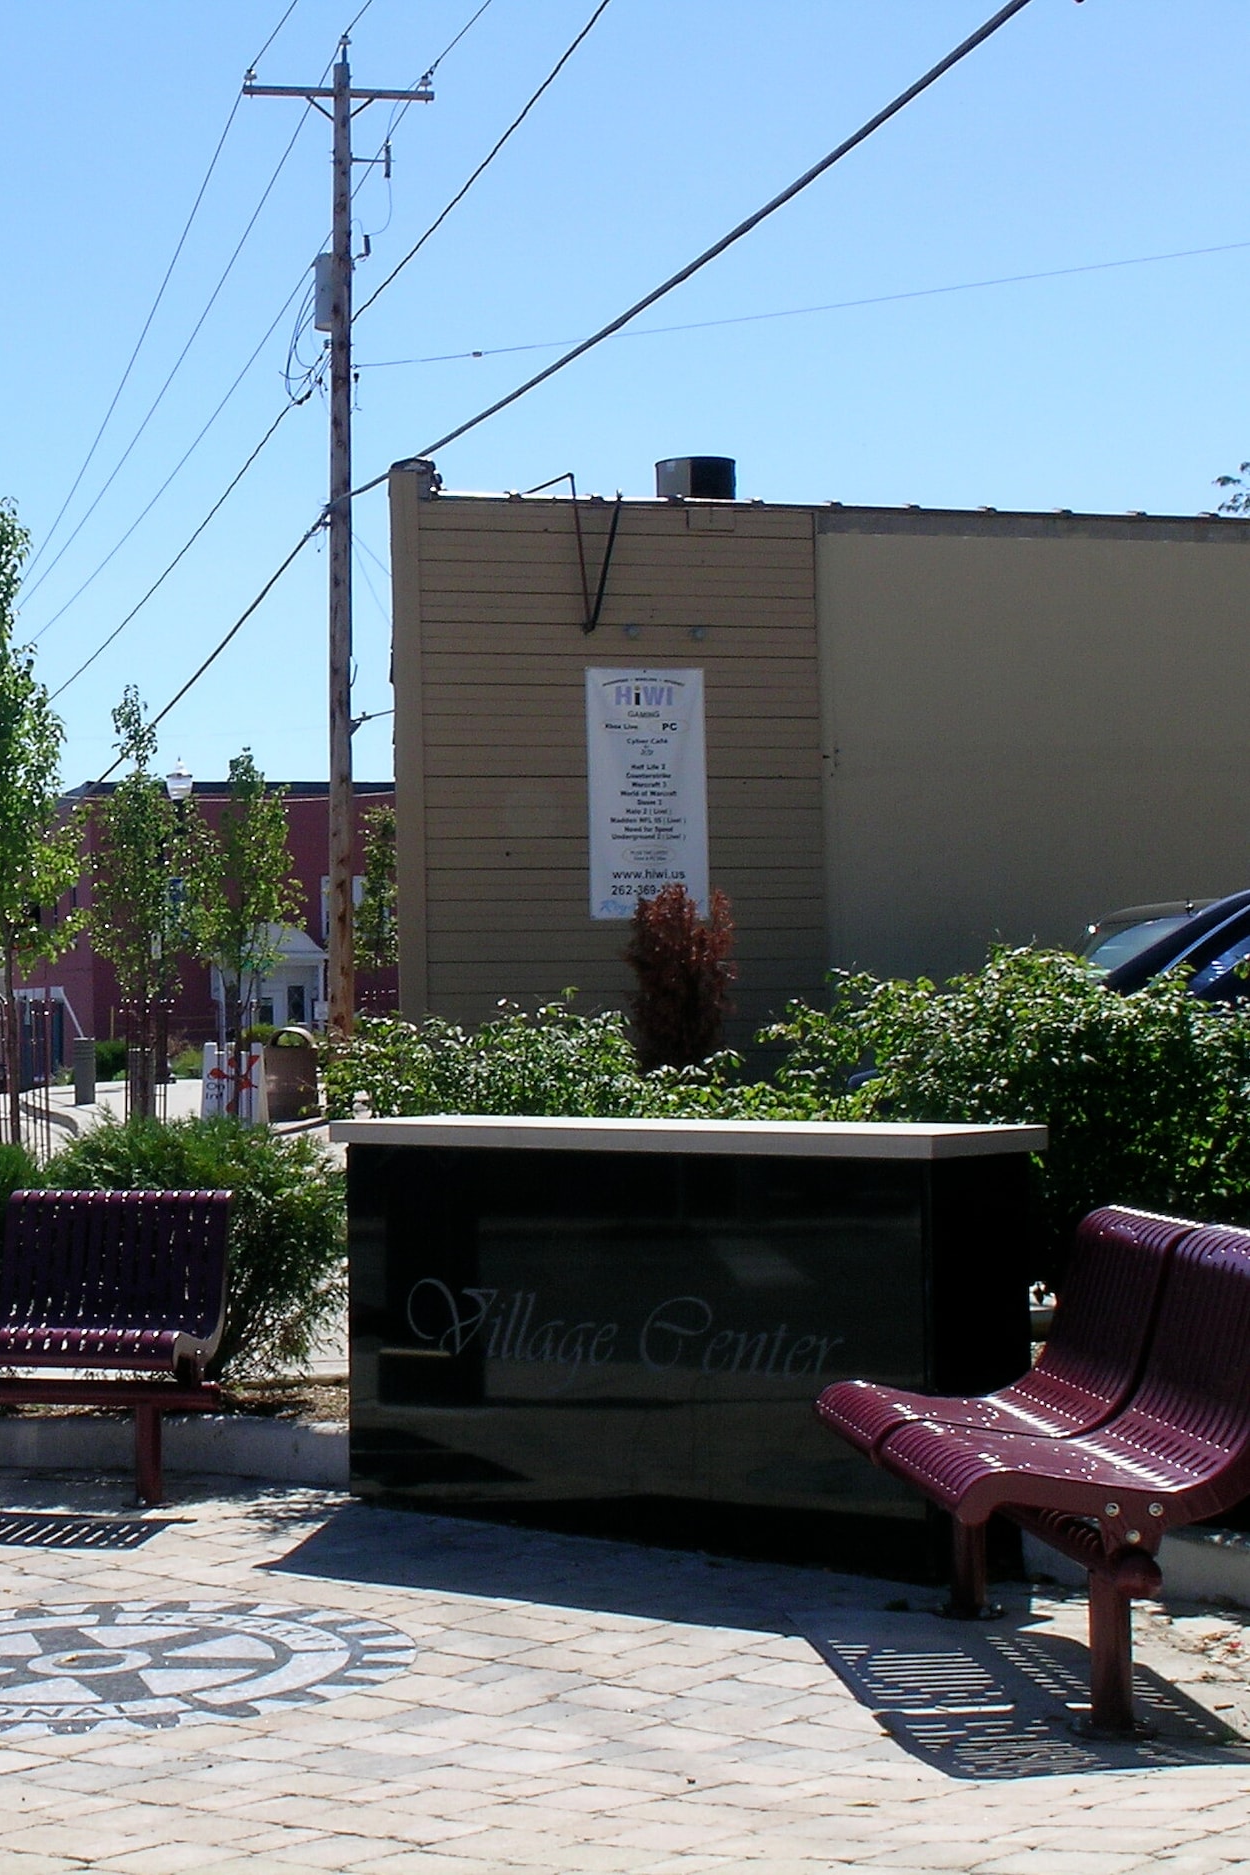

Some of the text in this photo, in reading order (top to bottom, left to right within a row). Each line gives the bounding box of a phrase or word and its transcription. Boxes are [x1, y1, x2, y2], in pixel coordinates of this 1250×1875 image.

[615, 685, 673, 706] HiWI
[662, 723, 678, 731] PC
[612, 868, 686, 879] www.hiwi.us
[611, 885, 688, 896] 262-369-
[407, 1278, 845, 1393] Village Center
[141, 1614, 333, 1644] ROTARY
